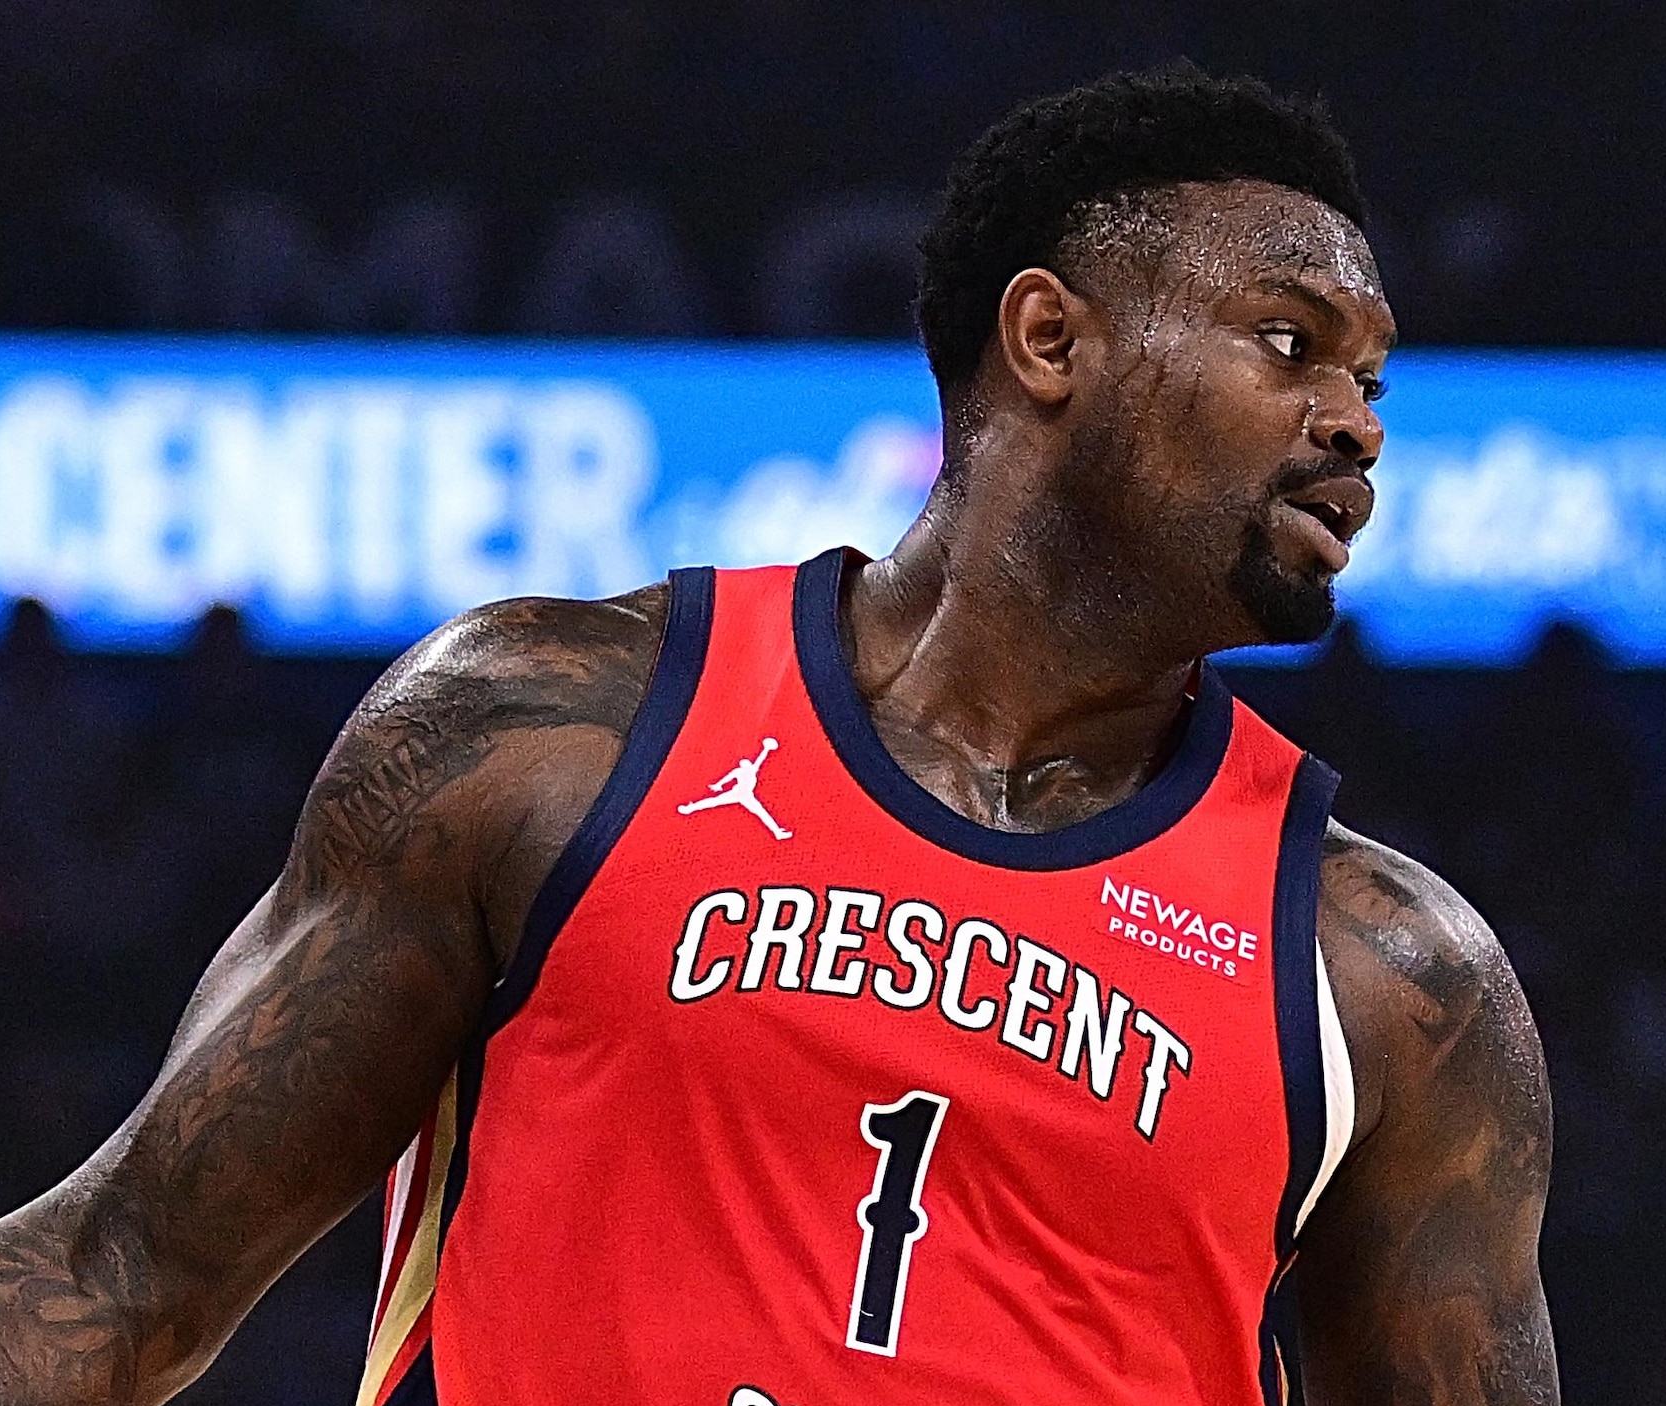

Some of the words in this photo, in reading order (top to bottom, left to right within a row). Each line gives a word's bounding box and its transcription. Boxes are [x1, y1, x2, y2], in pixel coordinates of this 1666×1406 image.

[1100, 875, 1258, 961] NEWAGE
[1108, 916, 1237, 977] PRODUCTS
[668, 886, 1191, 1144] CRESCENT
[844, 1089, 951, 1358] 1
